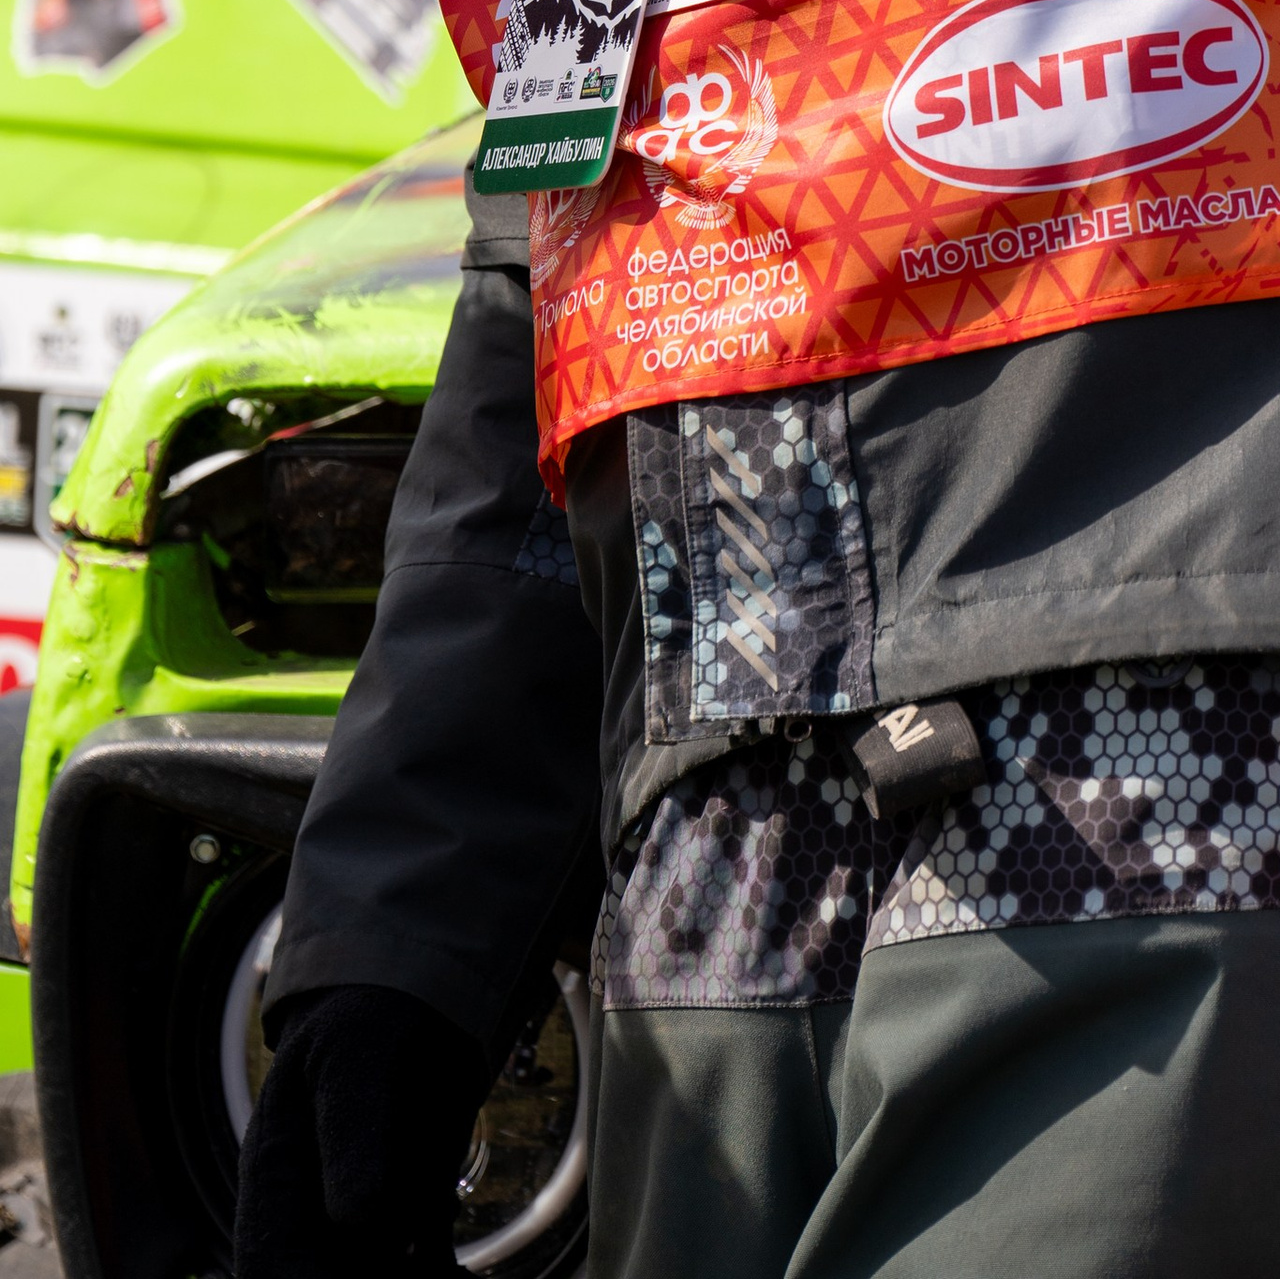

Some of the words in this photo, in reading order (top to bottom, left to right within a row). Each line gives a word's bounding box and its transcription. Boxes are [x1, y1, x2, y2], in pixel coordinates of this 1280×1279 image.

[913, 26, 1239, 140] SINTEC
[481, 143, 547, 171] АЛЕКСАНДР
[545, 136, 605, 165] ХАЙБУЛИН
[627, 227, 793, 284] федерация
[901, 203, 1131, 283] МОТОРНЫЕ
[540, 278, 606, 338] Триала
[625, 259, 800, 311] автоспорта
[616, 286, 808, 346] челябинской
[642, 330, 770, 373] области
